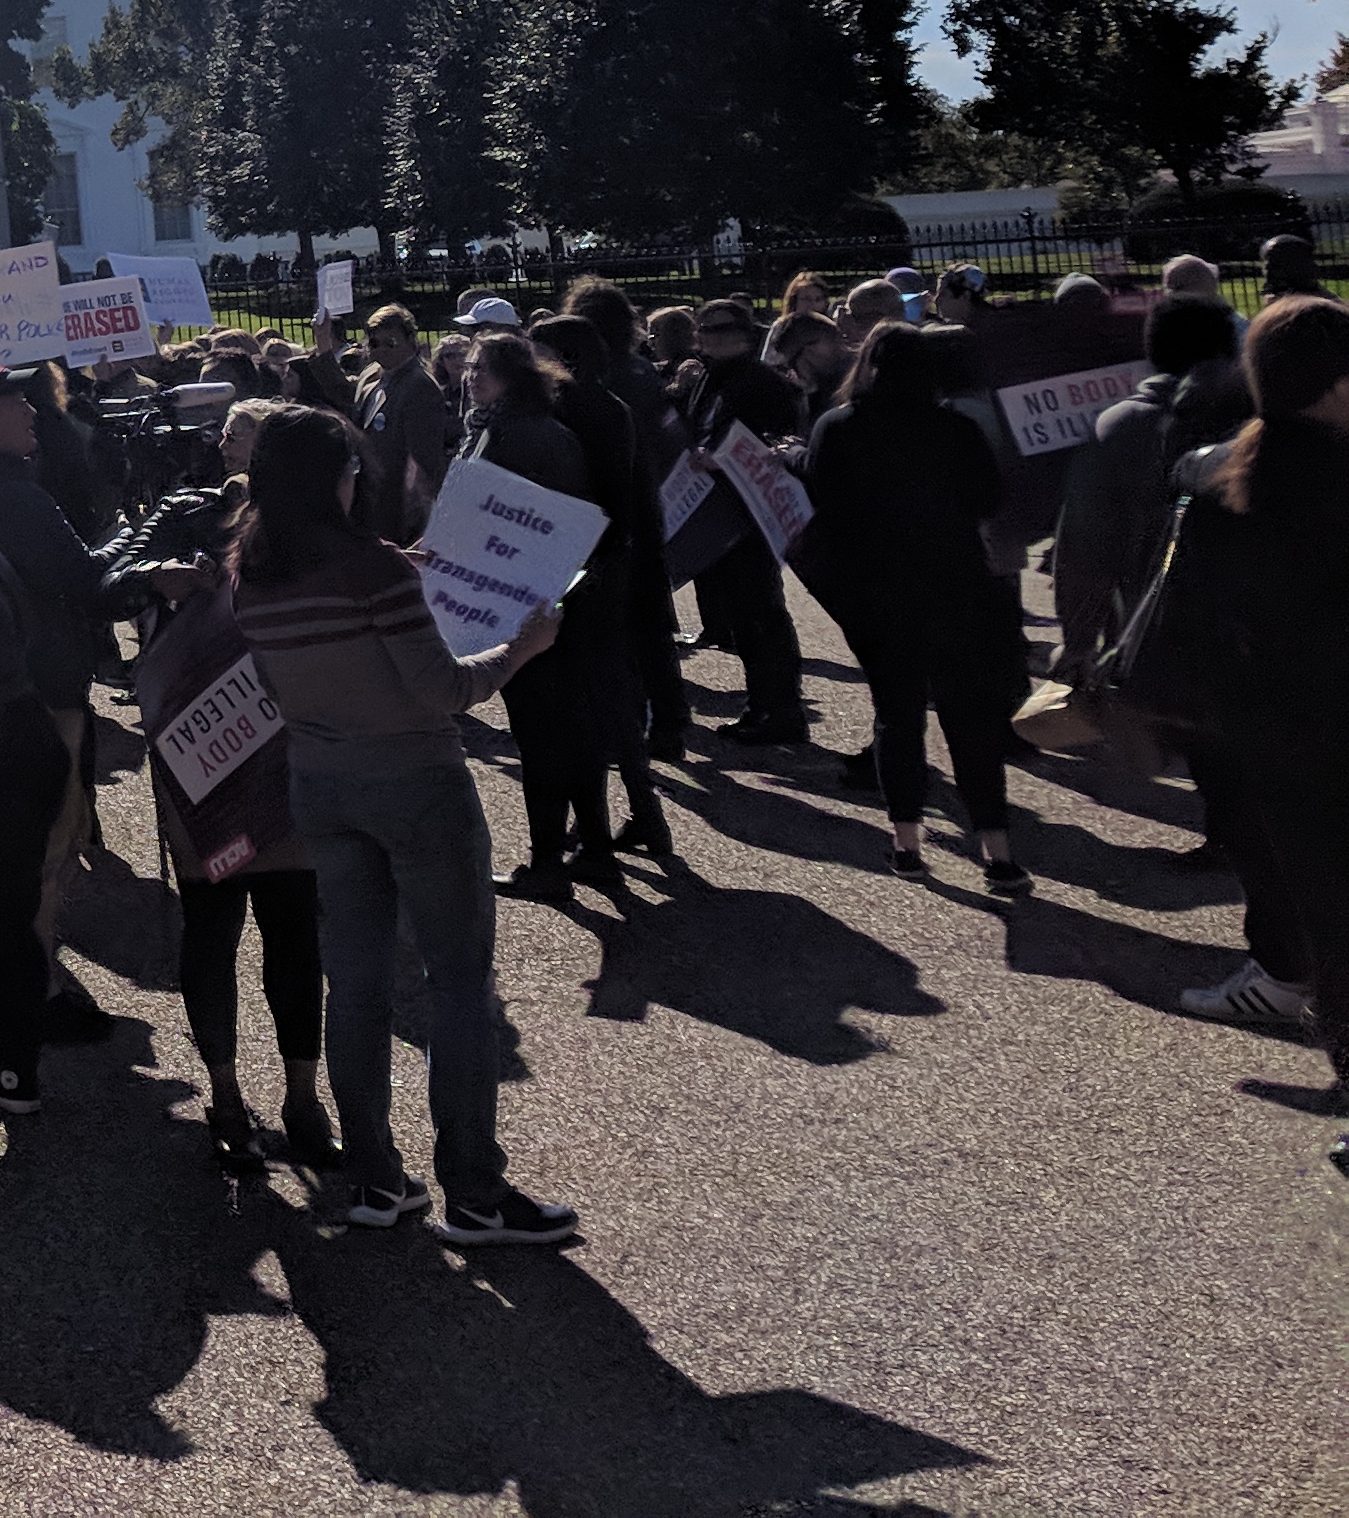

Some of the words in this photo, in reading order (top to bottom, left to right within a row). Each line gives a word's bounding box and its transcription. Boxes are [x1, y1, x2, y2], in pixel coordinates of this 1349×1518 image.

[8, 256, 49, 275] AND
[73, 298, 95, 311] WILL
[97, 294, 117, 308] NOT
[121, 292, 134, 304] BE
[64, 305, 141, 341] ERASED
[1024, 389, 1059, 416] NO
[1067, 372, 1133, 407] BODY
[1022, 422, 1050, 447] IS
[479, 494, 554, 535] Justice
[484, 535, 520, 560] For
[423, 549, 541, 607] Transgende
[431, 589, 501, 628] People
[166, 670, 257, 755] ILLEGAL
[258, 697, 277, 721] O
[197, 714, 258, 778] BODY
